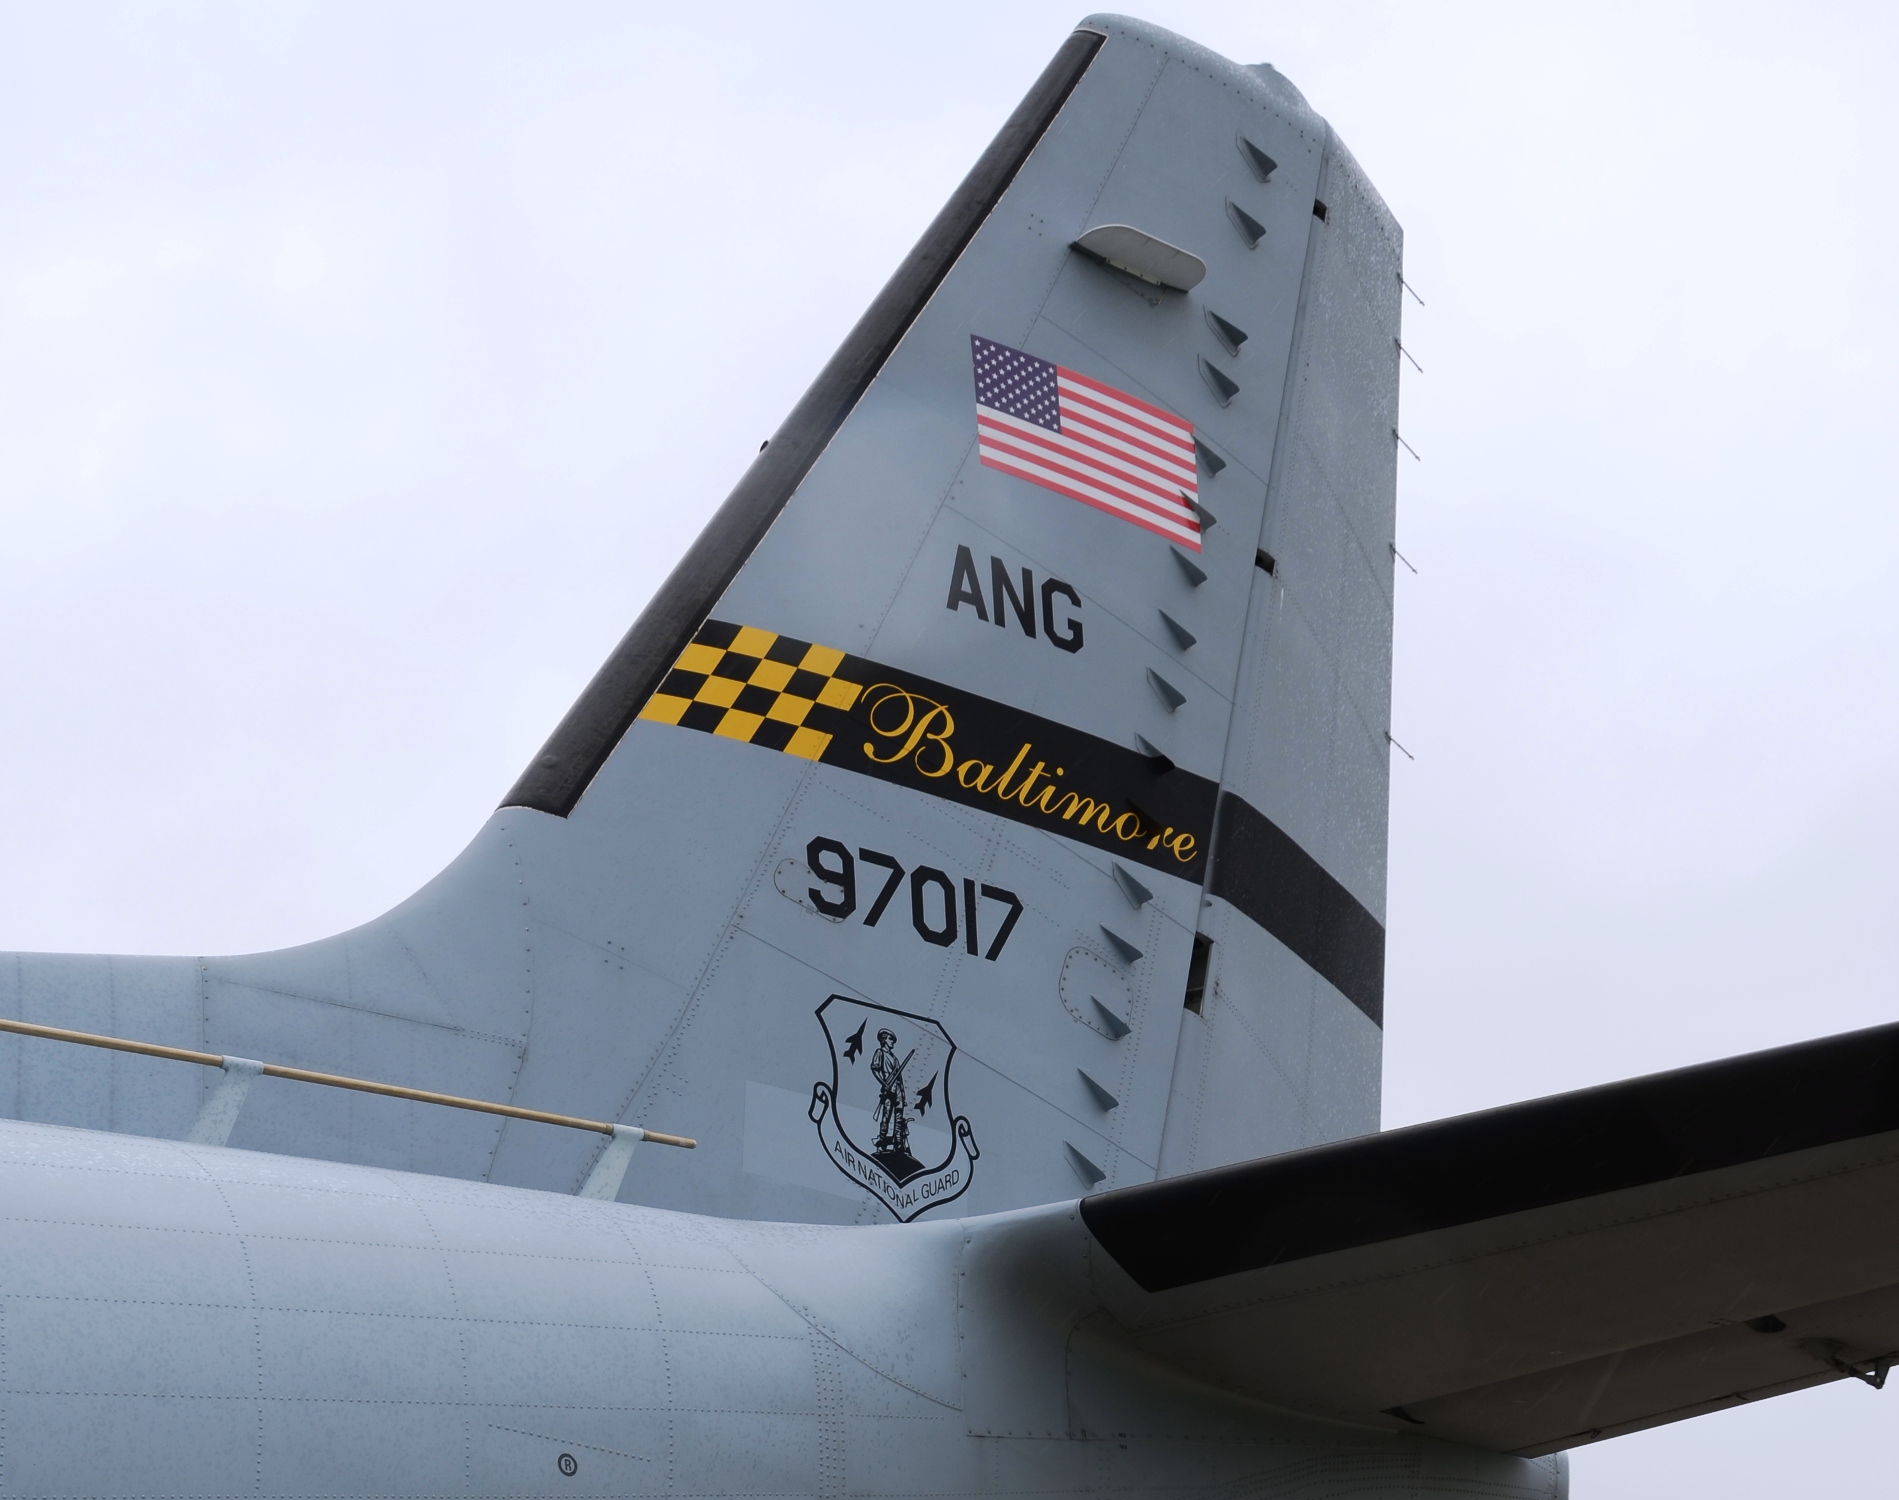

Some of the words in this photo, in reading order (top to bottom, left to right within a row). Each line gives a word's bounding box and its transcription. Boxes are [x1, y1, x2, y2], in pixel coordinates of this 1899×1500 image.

[946, 544, 1084, 654] ANG
[806, 836, 1024, 962] 97017
[834, 1140, 856, 1171] AIR
[857, 1160, 920, 1209] NATIONAL
[921, 1169, 960, 1199] GUARD
